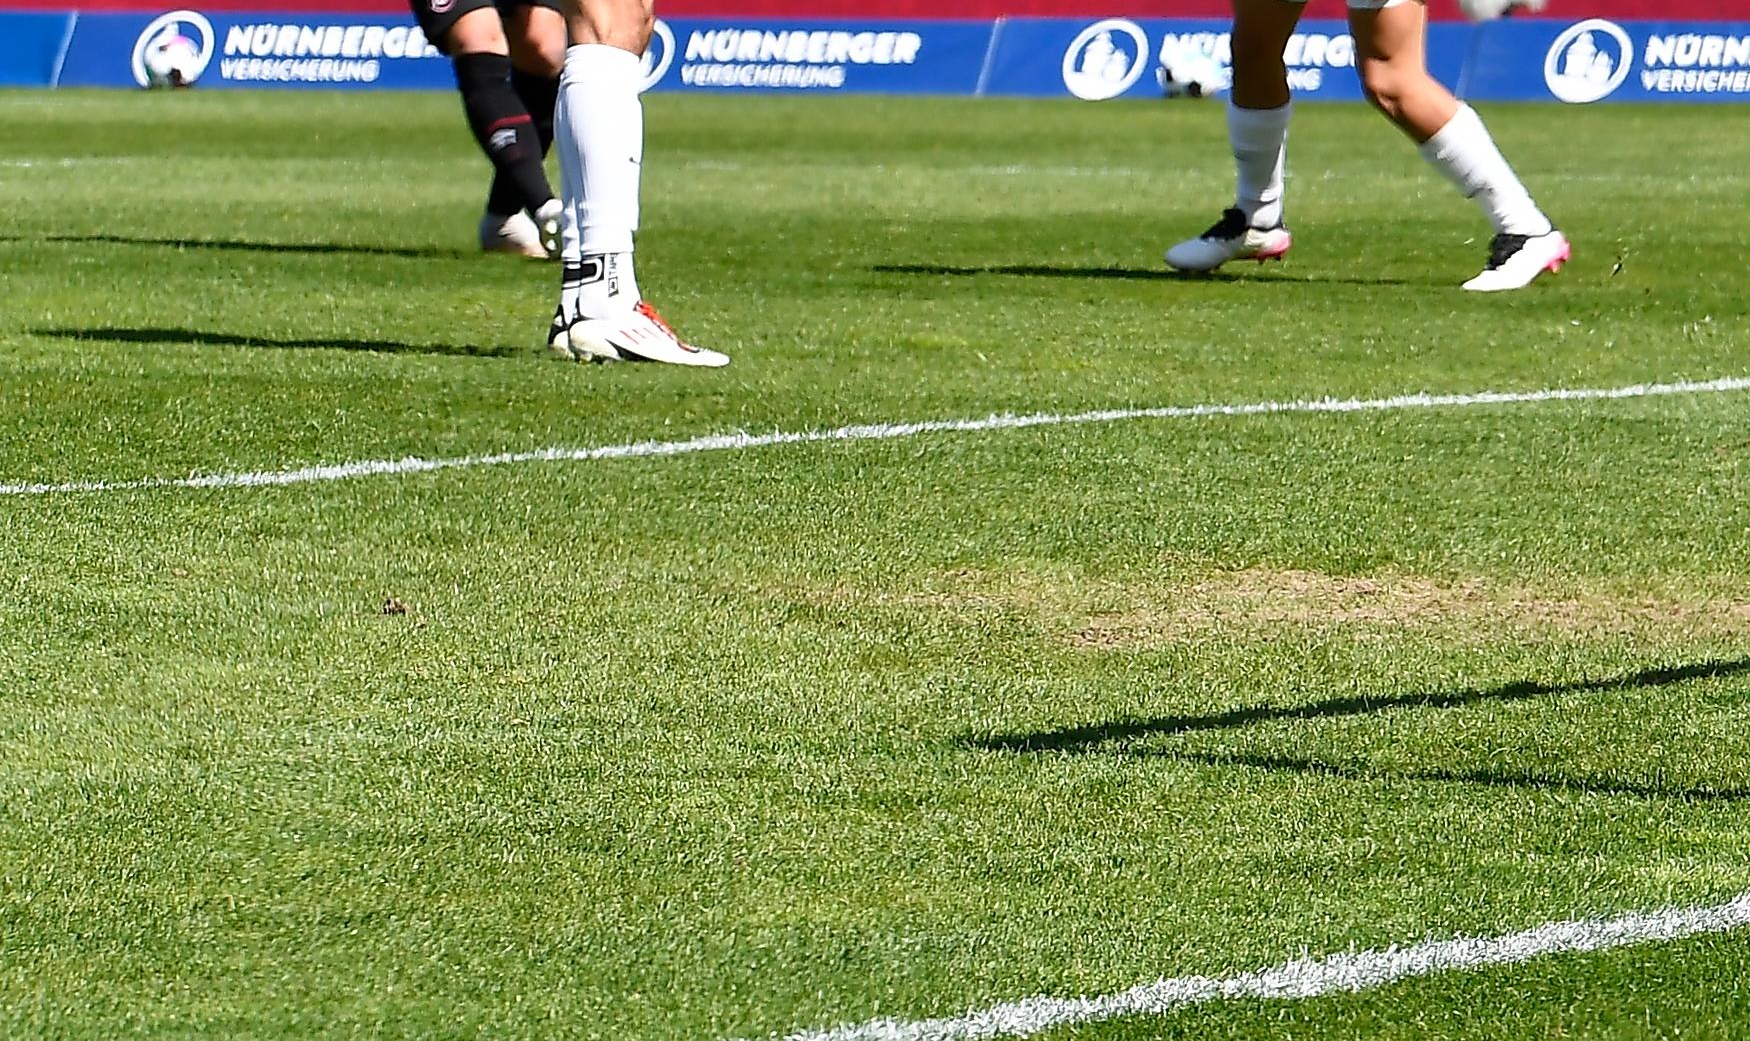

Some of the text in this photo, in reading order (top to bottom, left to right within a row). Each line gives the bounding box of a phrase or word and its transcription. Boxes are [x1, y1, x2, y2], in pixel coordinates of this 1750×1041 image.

[685, 28, 921, 64] NÜRNBERGER
[221, 59, 380, 82] VERSICHERUNG
[681, 64, 846, 87] VERSICHERUNG
